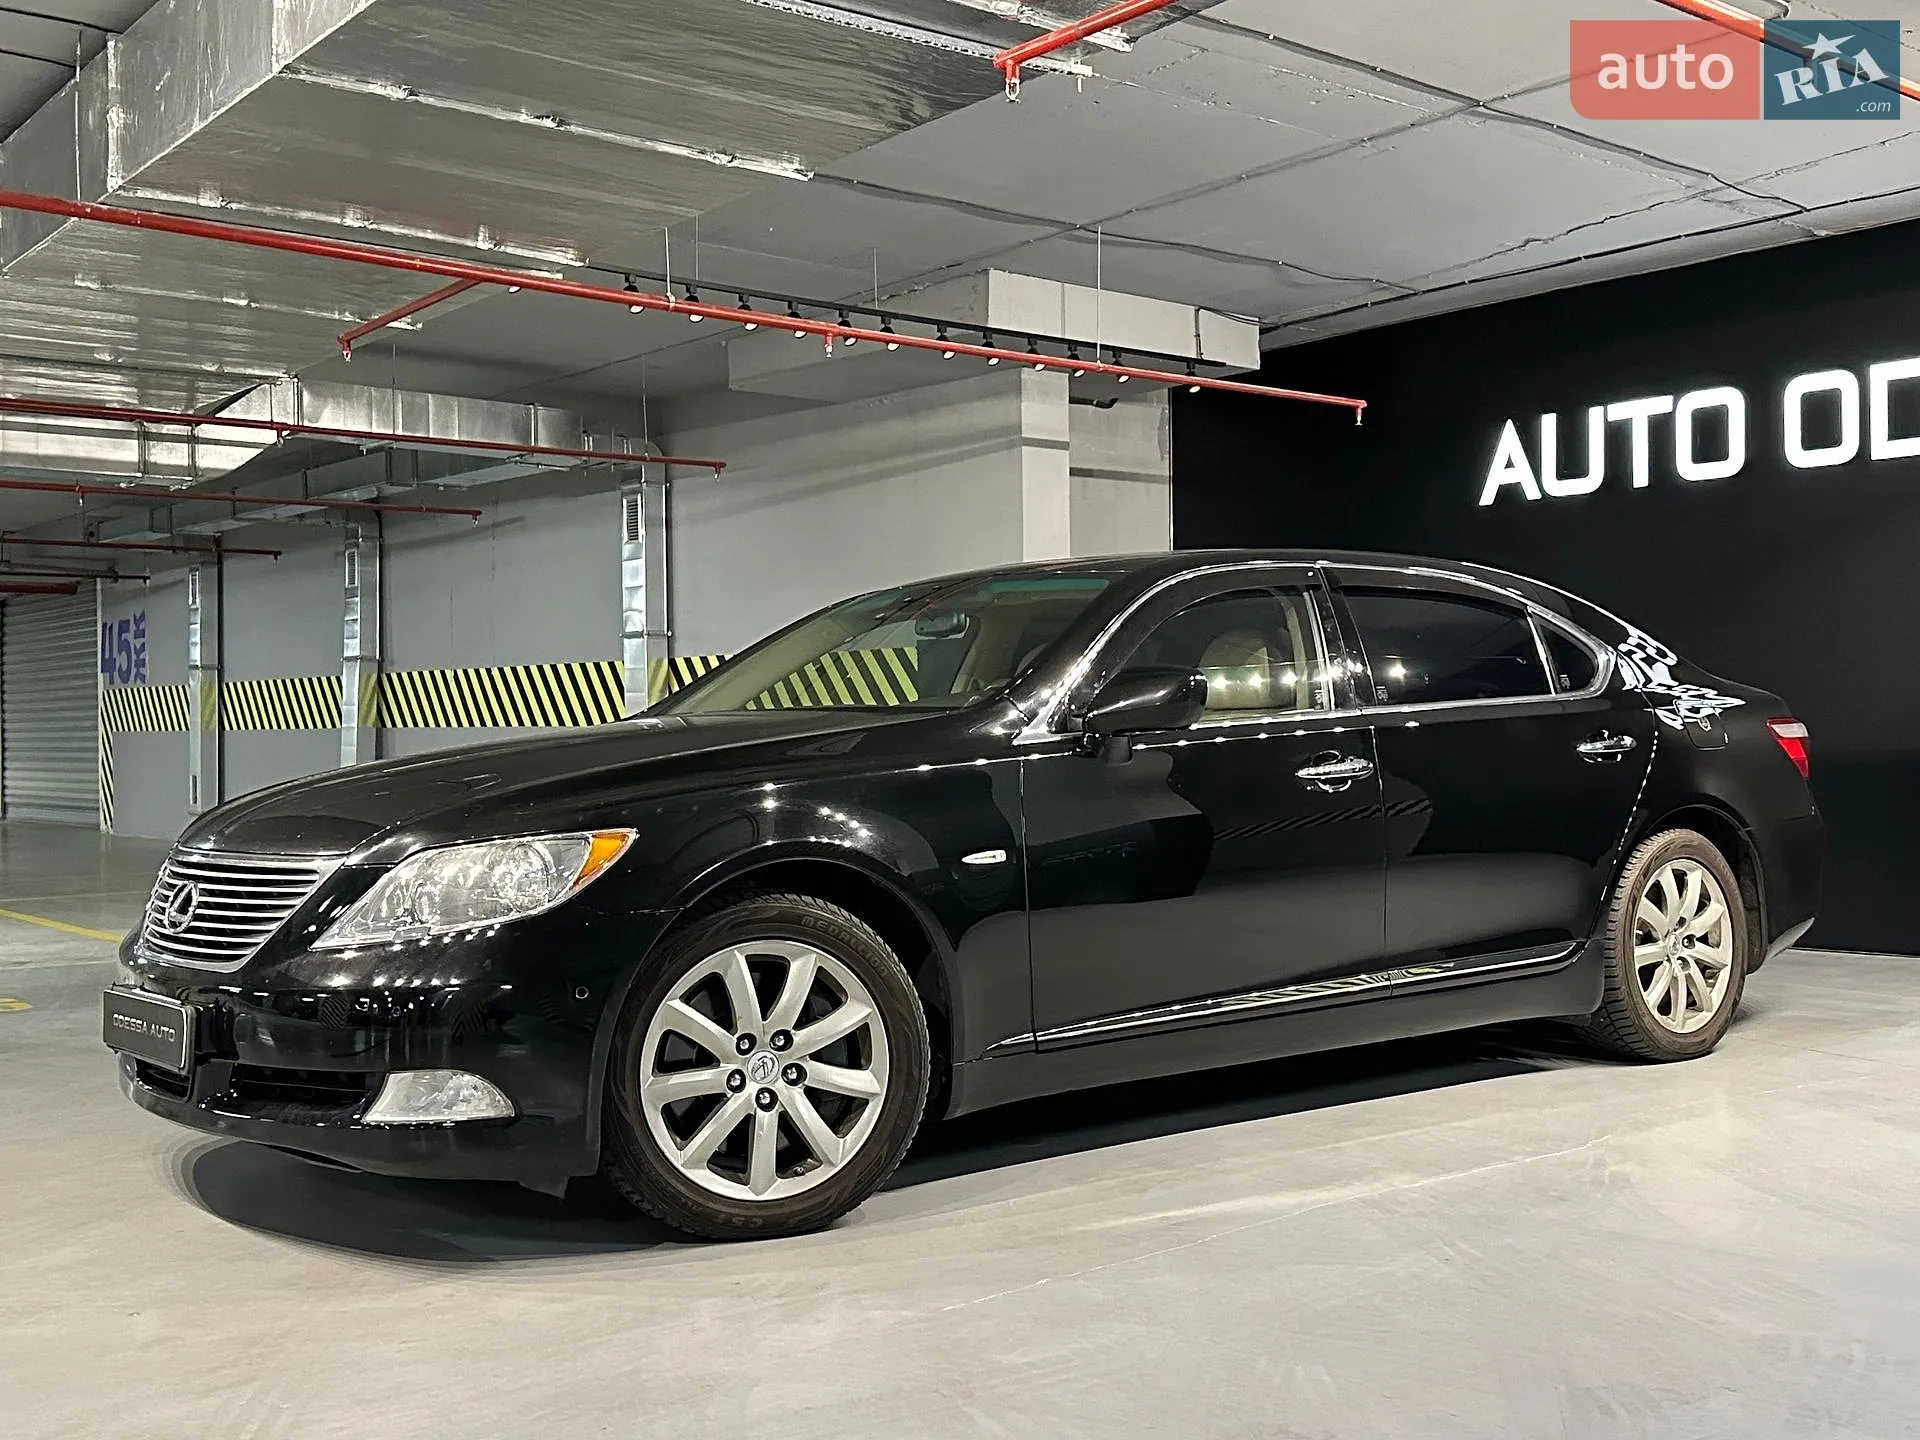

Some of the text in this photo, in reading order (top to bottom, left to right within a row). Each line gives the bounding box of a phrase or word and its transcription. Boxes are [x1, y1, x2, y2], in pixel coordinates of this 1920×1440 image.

[1479, 386, 1745, 506] AUTO
[101, 619, 132, 684] 45
[113, 1013, 176, 1042] ODESSA AUTO
